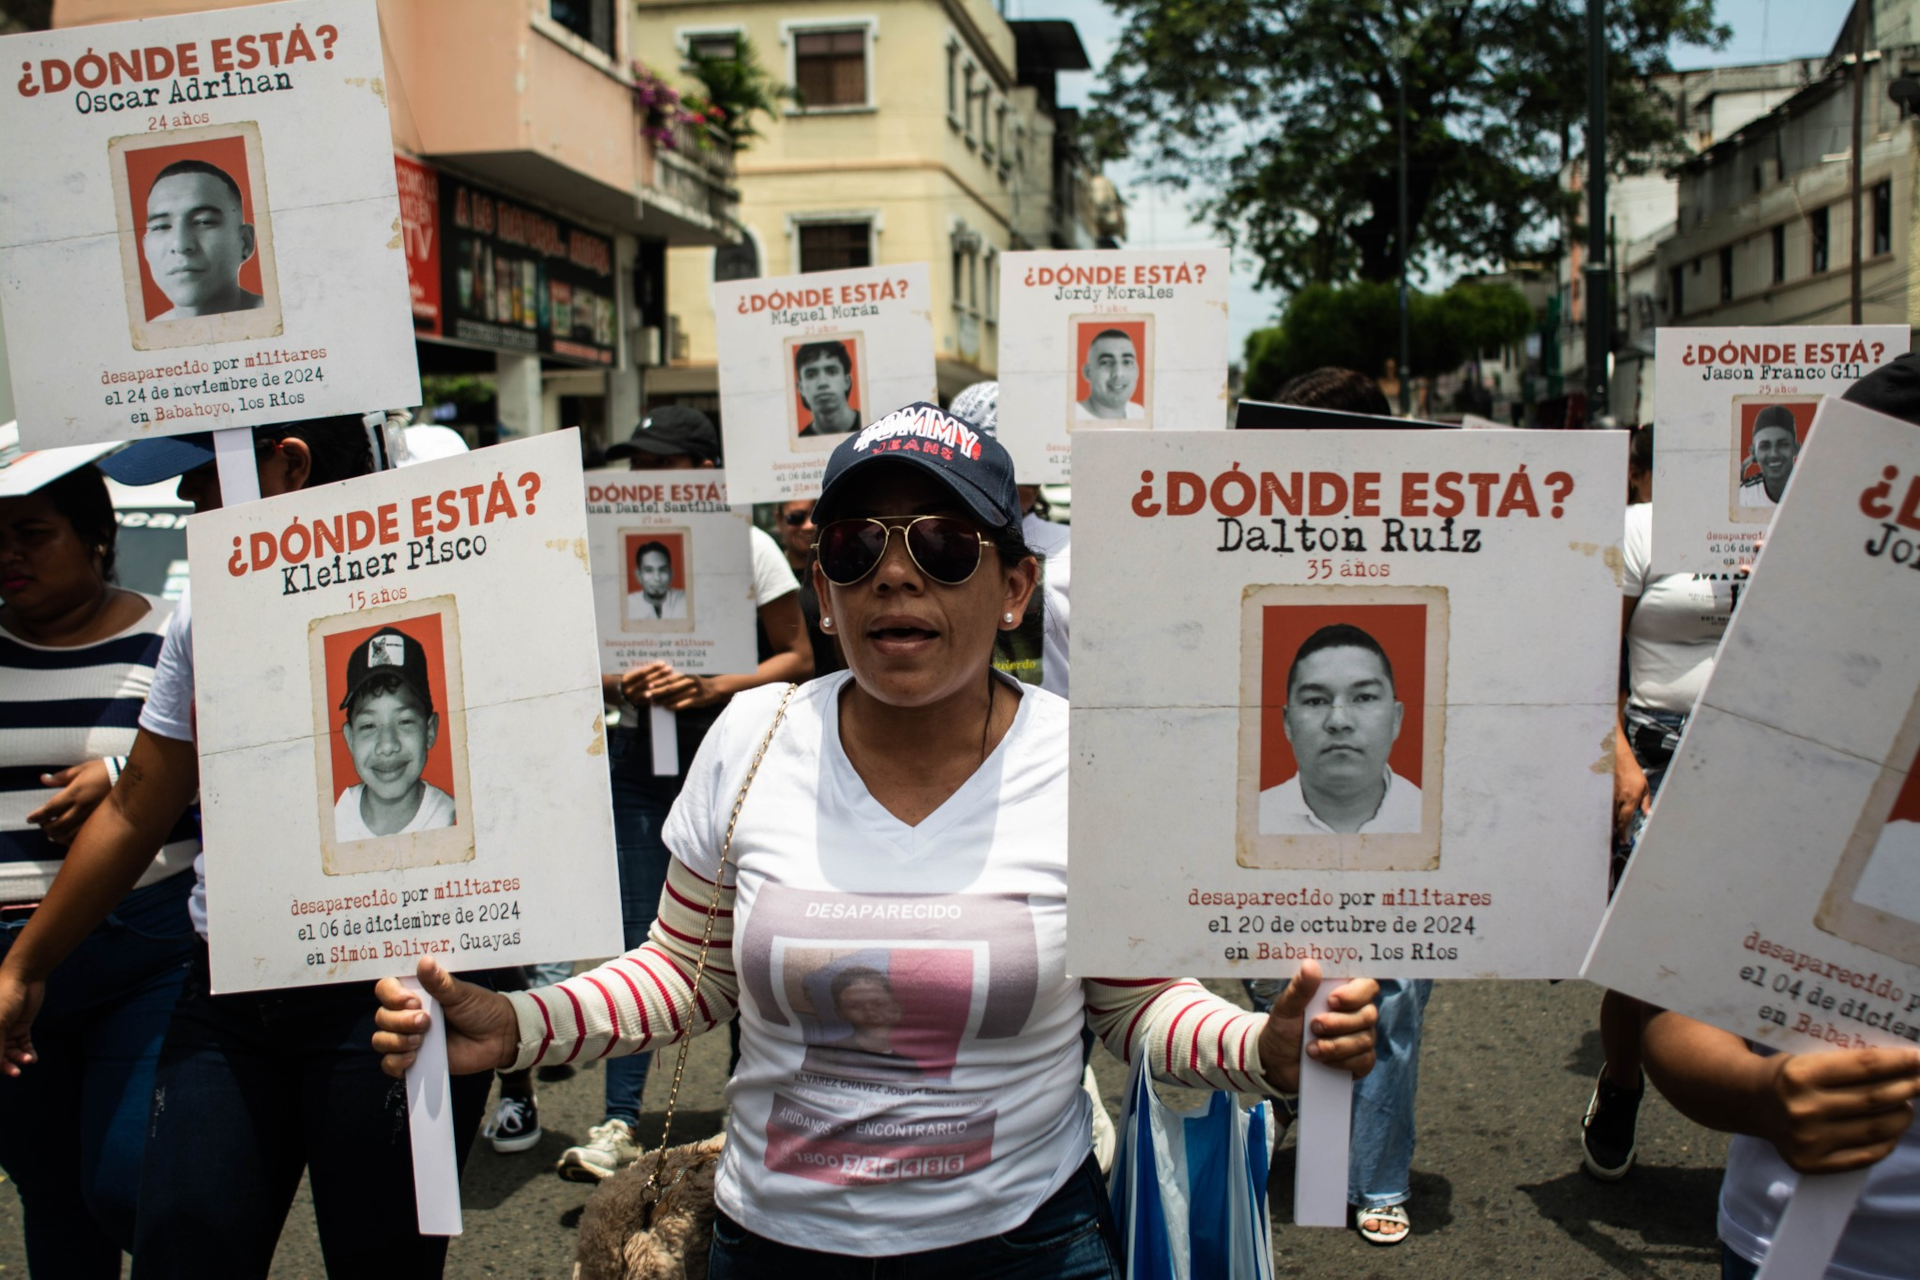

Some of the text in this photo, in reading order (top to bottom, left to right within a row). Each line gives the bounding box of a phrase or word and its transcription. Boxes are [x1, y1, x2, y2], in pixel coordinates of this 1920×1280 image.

[17, 23, 339, 97] ¿DÓNDE ESTÁ?
[76, 68, 294, 114] Oscar Adrihan
[148, 110, 210, 130] 24 años
[1024, 262, 1207, 286] ¿DÓNDE ESTÁ?
[737, 279, 909, 315] ¿DÓNDE ESTÁ?
[1055, 285, 1174, 302] Jordy Morales
[771, 302, 880, 326] Miguel Morán
[1682, 339, 1885, 366] ¿DÓNDE ESTÁ?
[101, 346, 328, 385] desaparecido por militares
[1703, 364, 1862, 381] Jason Franco Gil
[105, 366, 325, 406] el 24 de noviembre de 2024
[1759, 384, 1798, 394] 25 años
[130, 409, 151, 424] en
[154, 400, 236, 421] Babahoyo,
[239, 396, 265, 411] los
[853, 406, 980, 460] TOMMY
[872, 439, 954, 461] JEANS
[773, 459, 826, 471] desaparecid
[586, 483, 664, 502] DÓNDE
[1131, 462, 1575, 519] ¿DÓNDE ESTÁ?
[616, 501, 659, 514] Daniel
[227, 472, 541, 577] ¿DÓNDE ESTÁ?
[1217, 517, 1482, 554] Dalton Ruiz
[1710, 544, 1721, 553] el
[1724, 544, 1736, 553] 06
[1738, 544, 1751, 553] de
[281, 535, 488, 596] Kleiner Pisco
[1307, 559, 1390, 579] 35 años
[348, 585, 408, 609] 15 años
[291, 874, 520, 917] desaparecido por militares
[1188, 888, 1492, 910] desaparecido por militares
[298, 901, 520, 941] el 06 de diciembre de 2024
[805, 902, 962, 919] DESAPARECIDO
[1208, 915, 1476, 935] el 20 de octubre de 2024
[306, 929, 521, 966] en Simón Bolívar, Guayas
[1224, 943, 1250, 960] en
[1256, 943, 1363, 963] Babahoyo,
[1370, 944, 1404, 961] los
[1743, 931, 1903, 1002] desaparecido
[1739, 965, 1767, 987] el
[1772, 973, 1803, 1000] 04
[1806, 985, 1836, 1010] de
[1839, 997, 1920, 1041] diciem
[1758, 1003, 1787, 1026] en
[795, 1074, 837, 1088] ALVAREZ
[840, 1079, 882, 1094] CHAVEZ
[780, 1106, 831, 1135] AYÚDANOS
[856, 1121, 967, 1137] ENCONTRARLO
[794, 1152, 839, 1168] 1800
